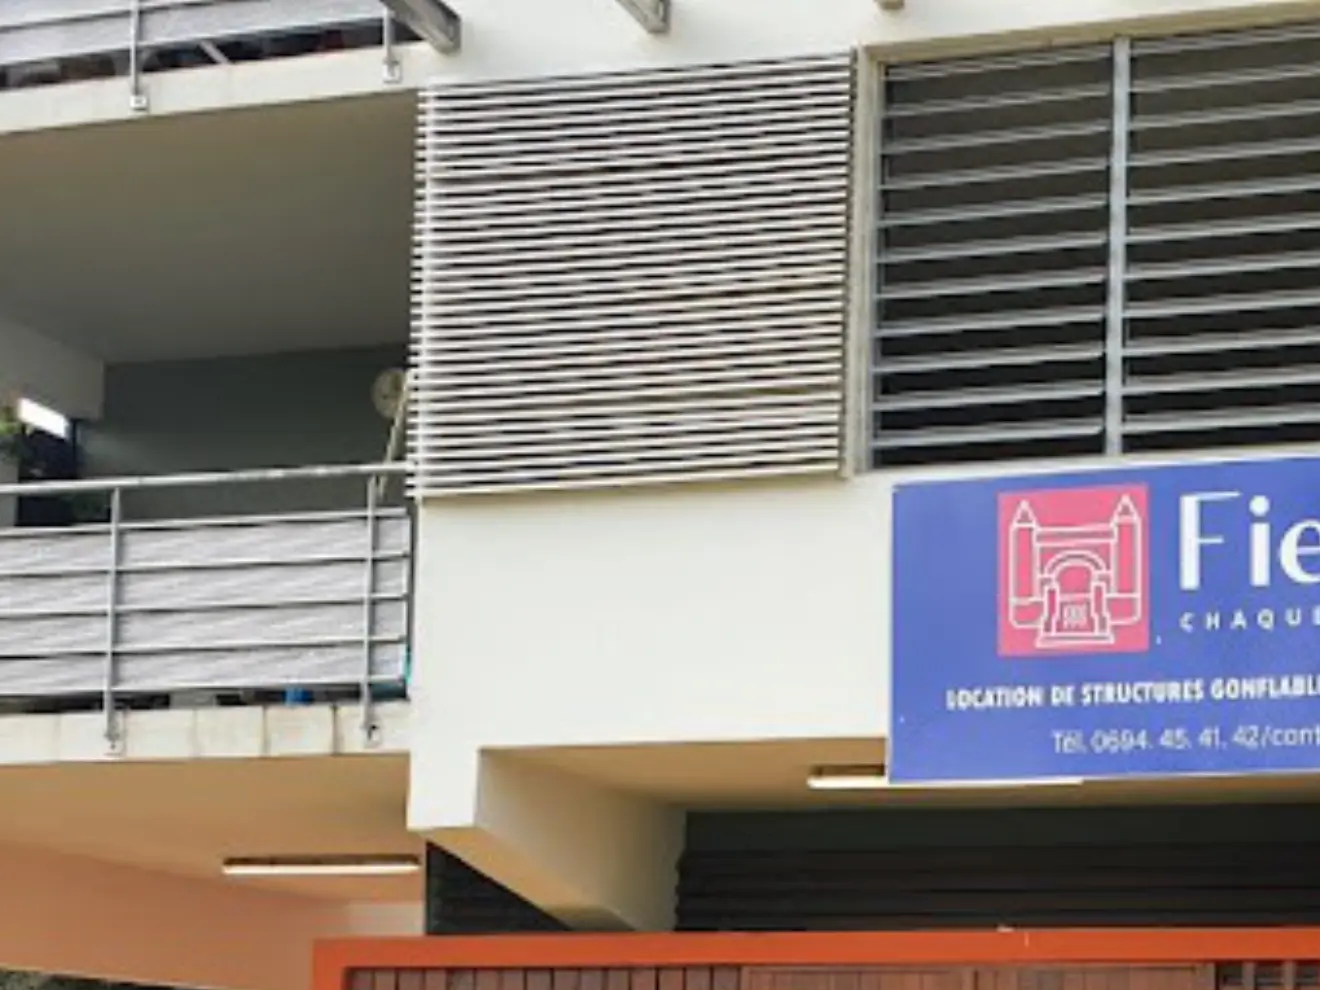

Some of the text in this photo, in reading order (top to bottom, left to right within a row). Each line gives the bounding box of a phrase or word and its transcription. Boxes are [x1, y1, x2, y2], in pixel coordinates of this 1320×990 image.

[945, 683, 1046, 711] LOCATION
[1050, 684, 1076, 708] DE
[1081, 677, 1205, 707] STRUCTURES
